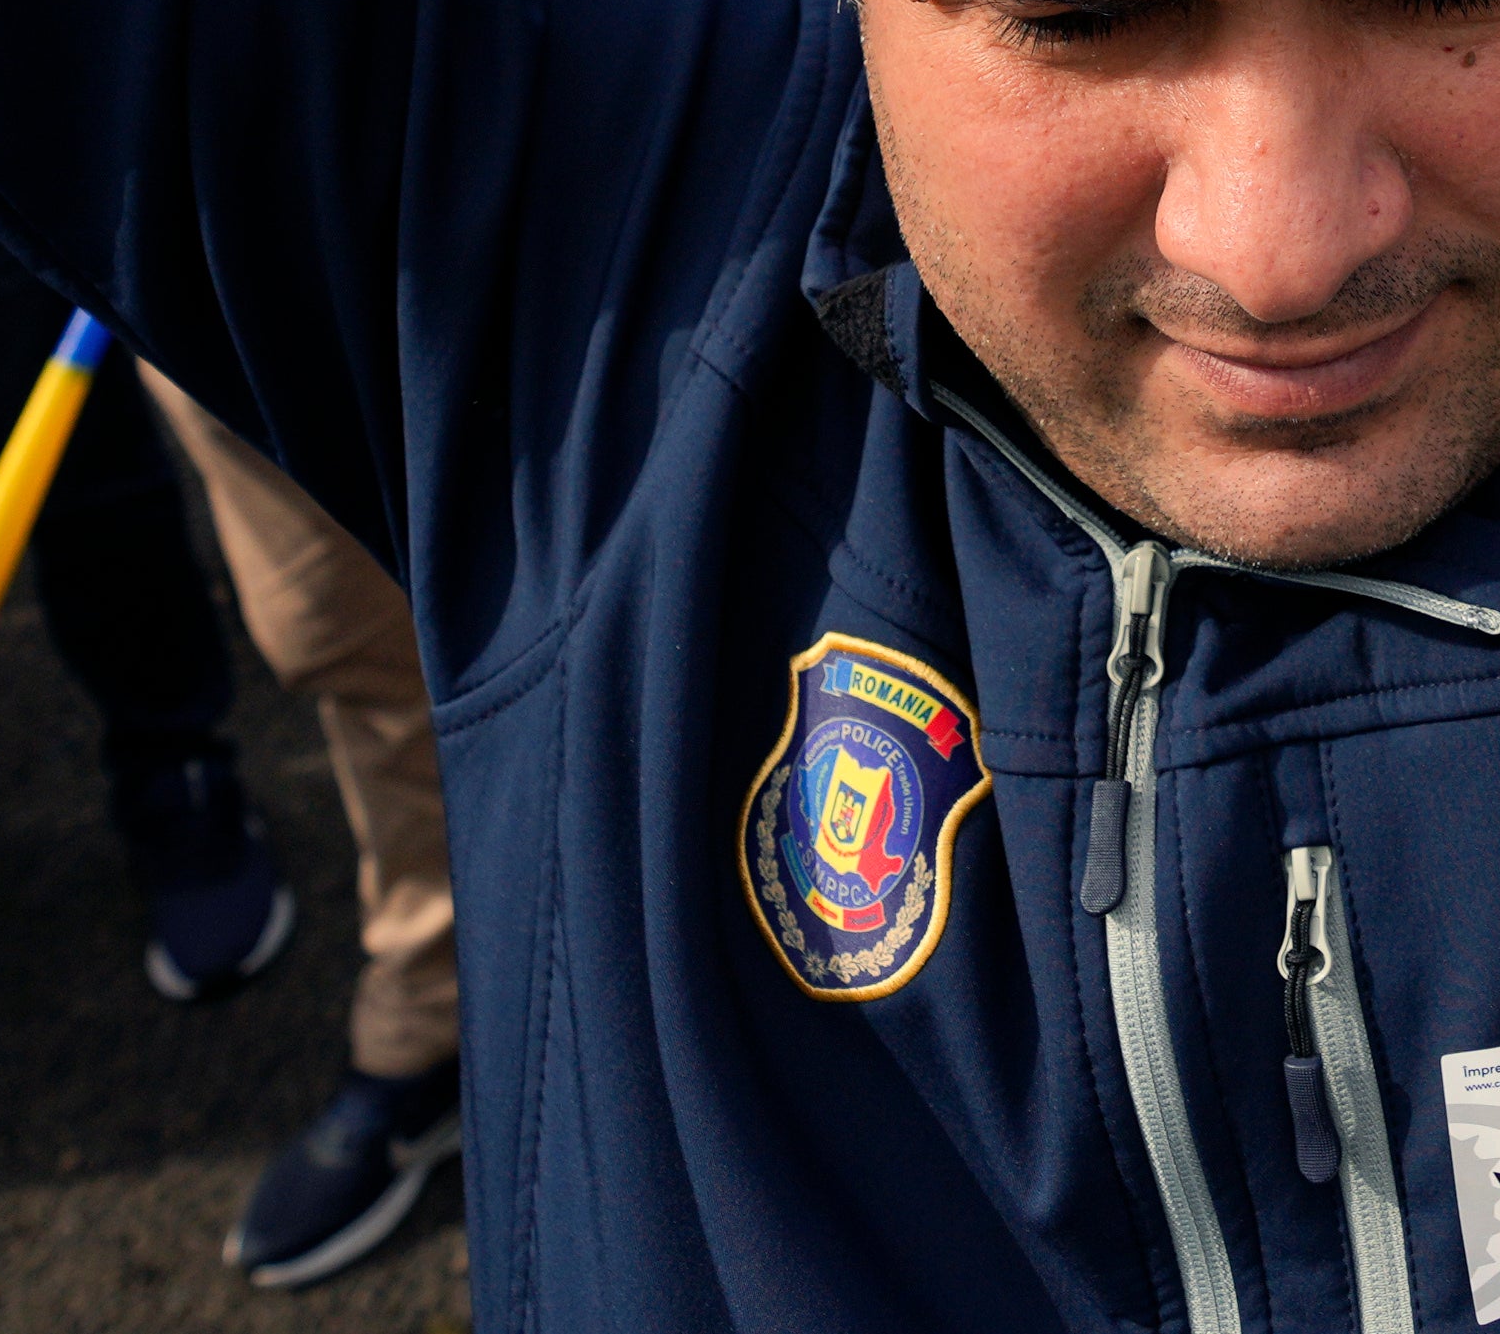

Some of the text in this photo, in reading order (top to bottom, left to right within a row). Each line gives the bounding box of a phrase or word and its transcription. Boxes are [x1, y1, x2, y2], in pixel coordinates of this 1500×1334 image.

[851, 671, 934, 724] ROMANIA
[840, 722, 903, 768] POLICE
[894, 762, 912, 797] Trade
[900, 797, 915, 836] Union
